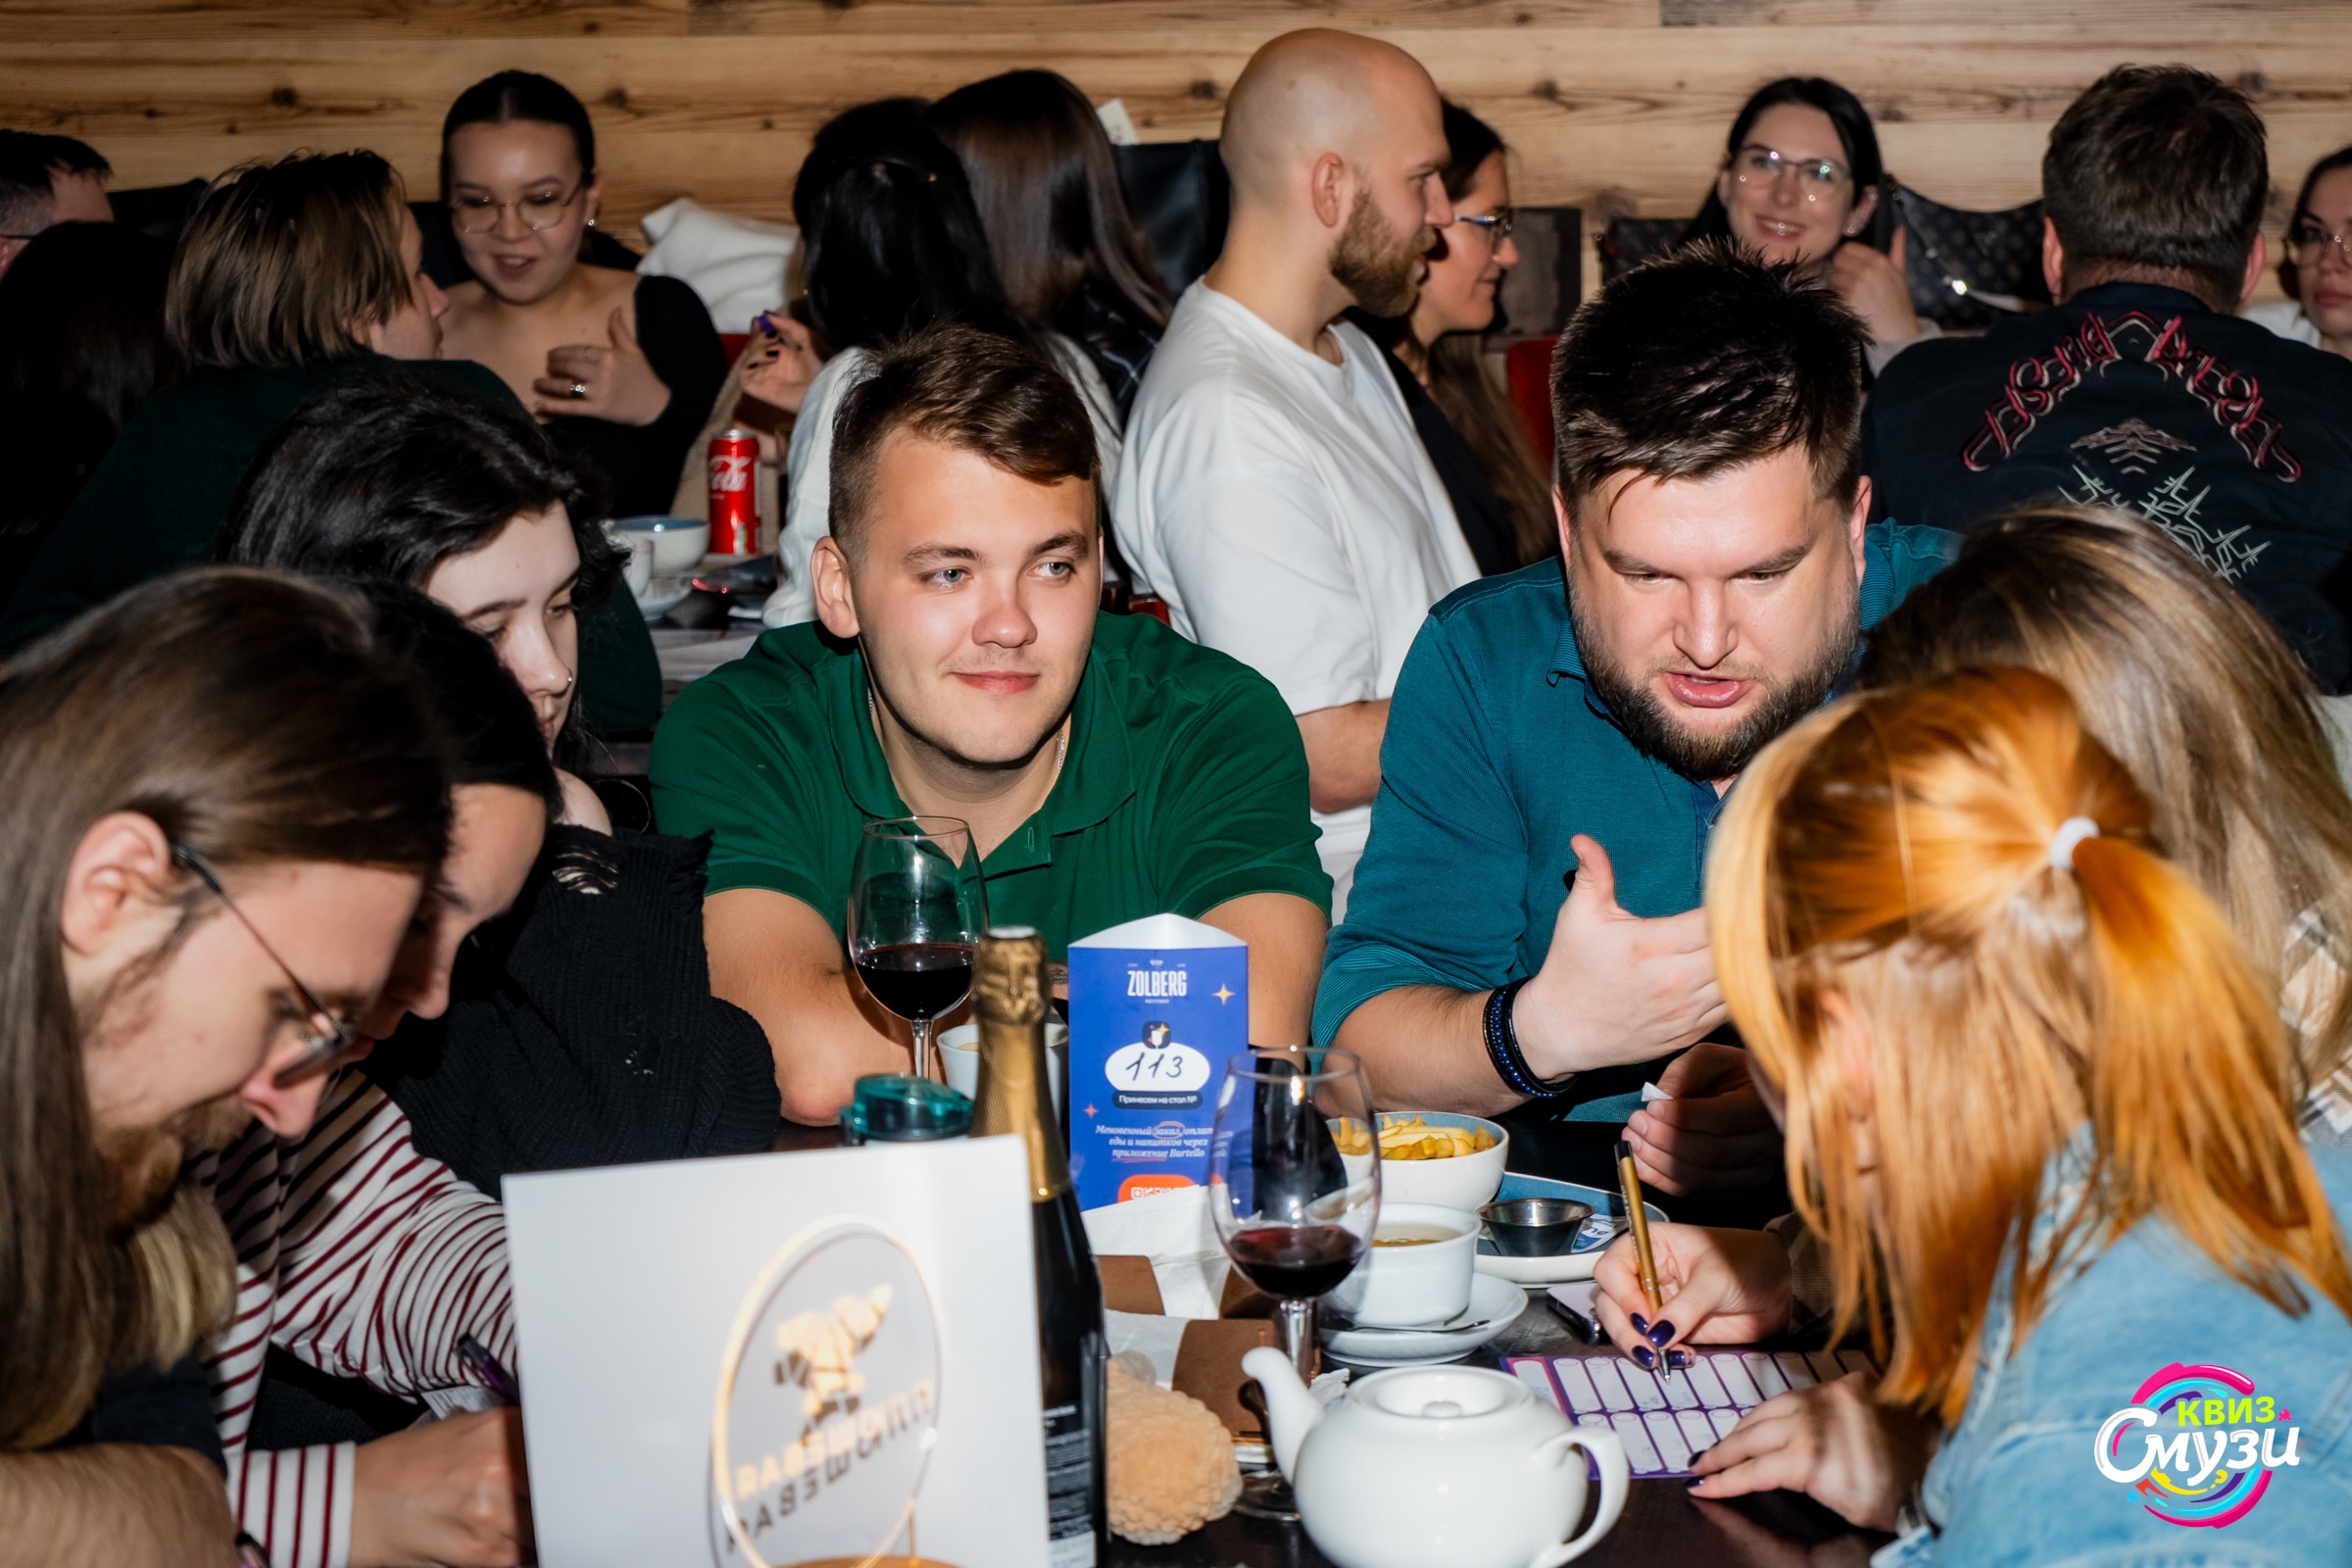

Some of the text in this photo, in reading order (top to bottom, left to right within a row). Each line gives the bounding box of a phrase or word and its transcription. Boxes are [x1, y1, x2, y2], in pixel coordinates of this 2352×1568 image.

[1127, 970, 1188, 997] ZOLBERG
[1125, 1051, 1184, 1081] 113
[1118, 1095, 1157, 1104] Принесем
[1168, 1096, 1187, 1104] стол
[1096, 1125, 1152, 1136] Мгновенный
[1108, 1137, 1126, 1147] еды
[1183, 1138, 1208, 1148] через
[1112, 1148, 1205, 1158] приложение Bartello
